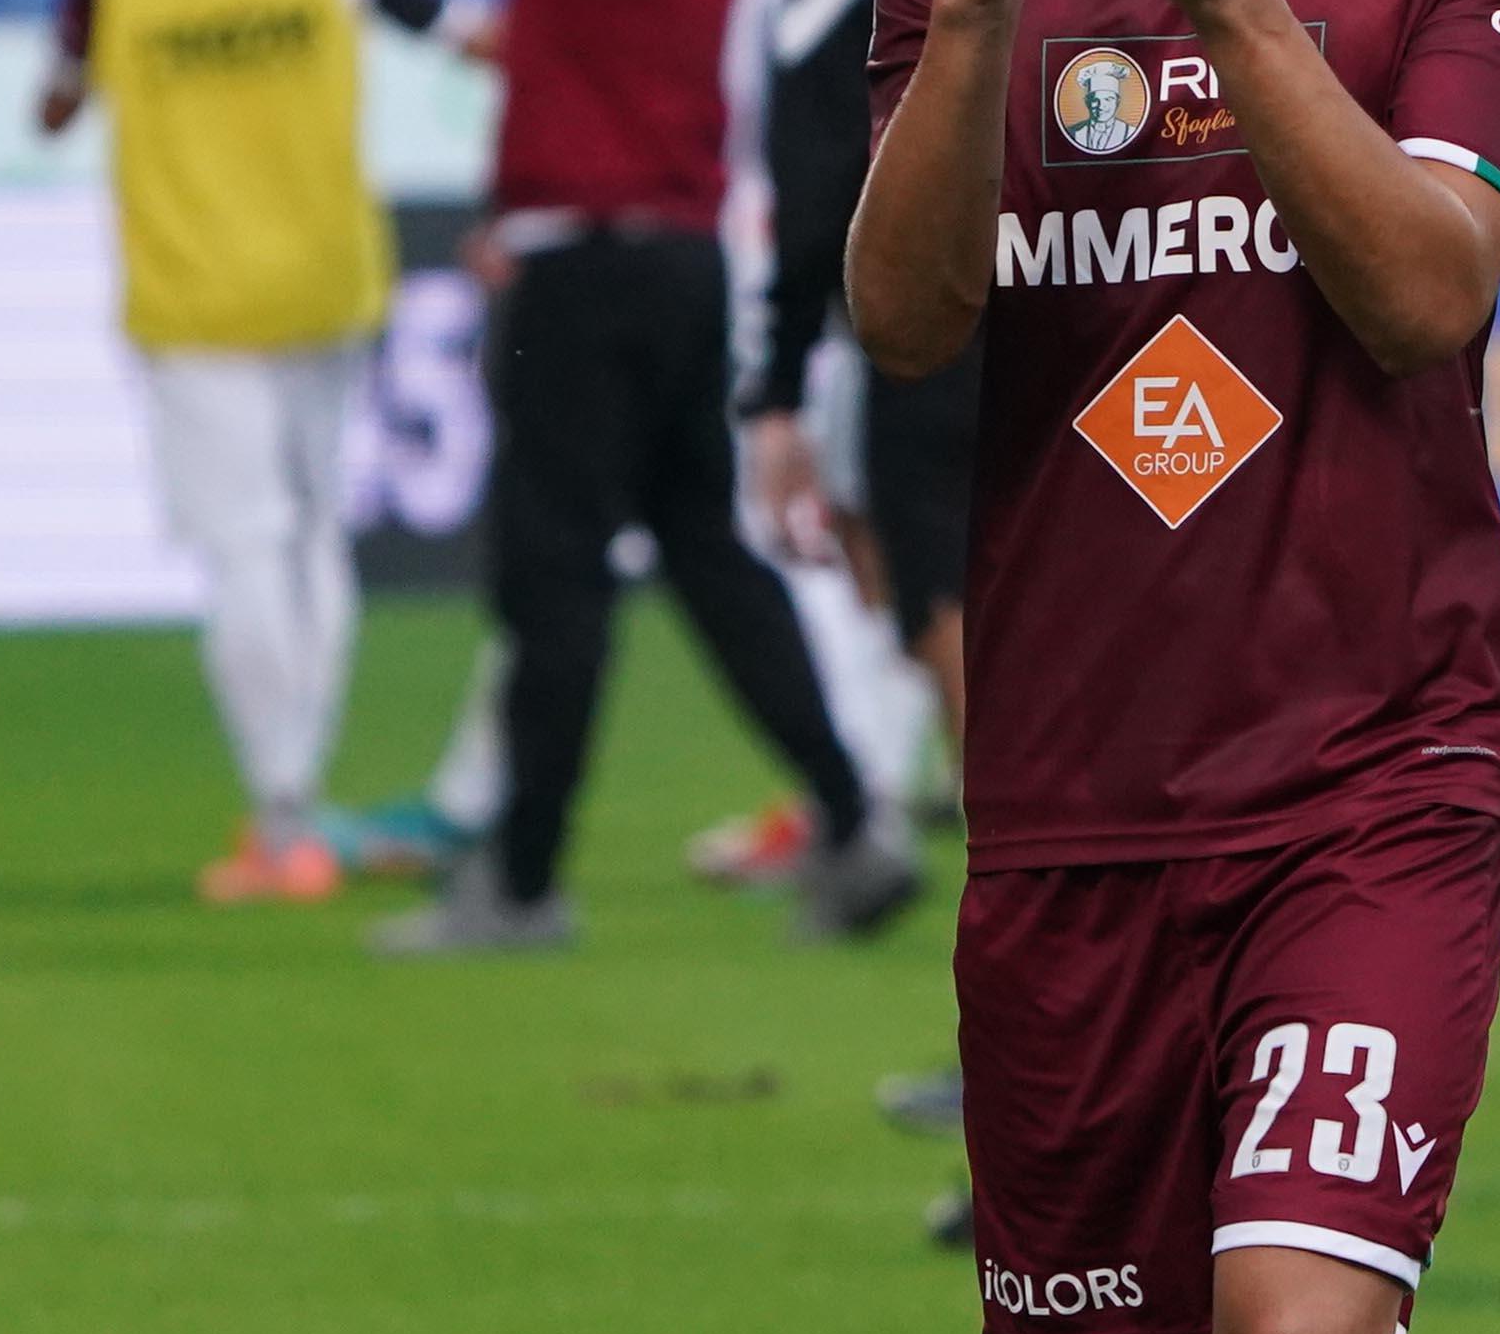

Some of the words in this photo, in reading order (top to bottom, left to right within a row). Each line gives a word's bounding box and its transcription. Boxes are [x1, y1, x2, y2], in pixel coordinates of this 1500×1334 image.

[1133, 376, 1225, 449] EA
[1133, 451, 1226, 476] GROUP
[1230, 1021, 1398, 1183] 23
